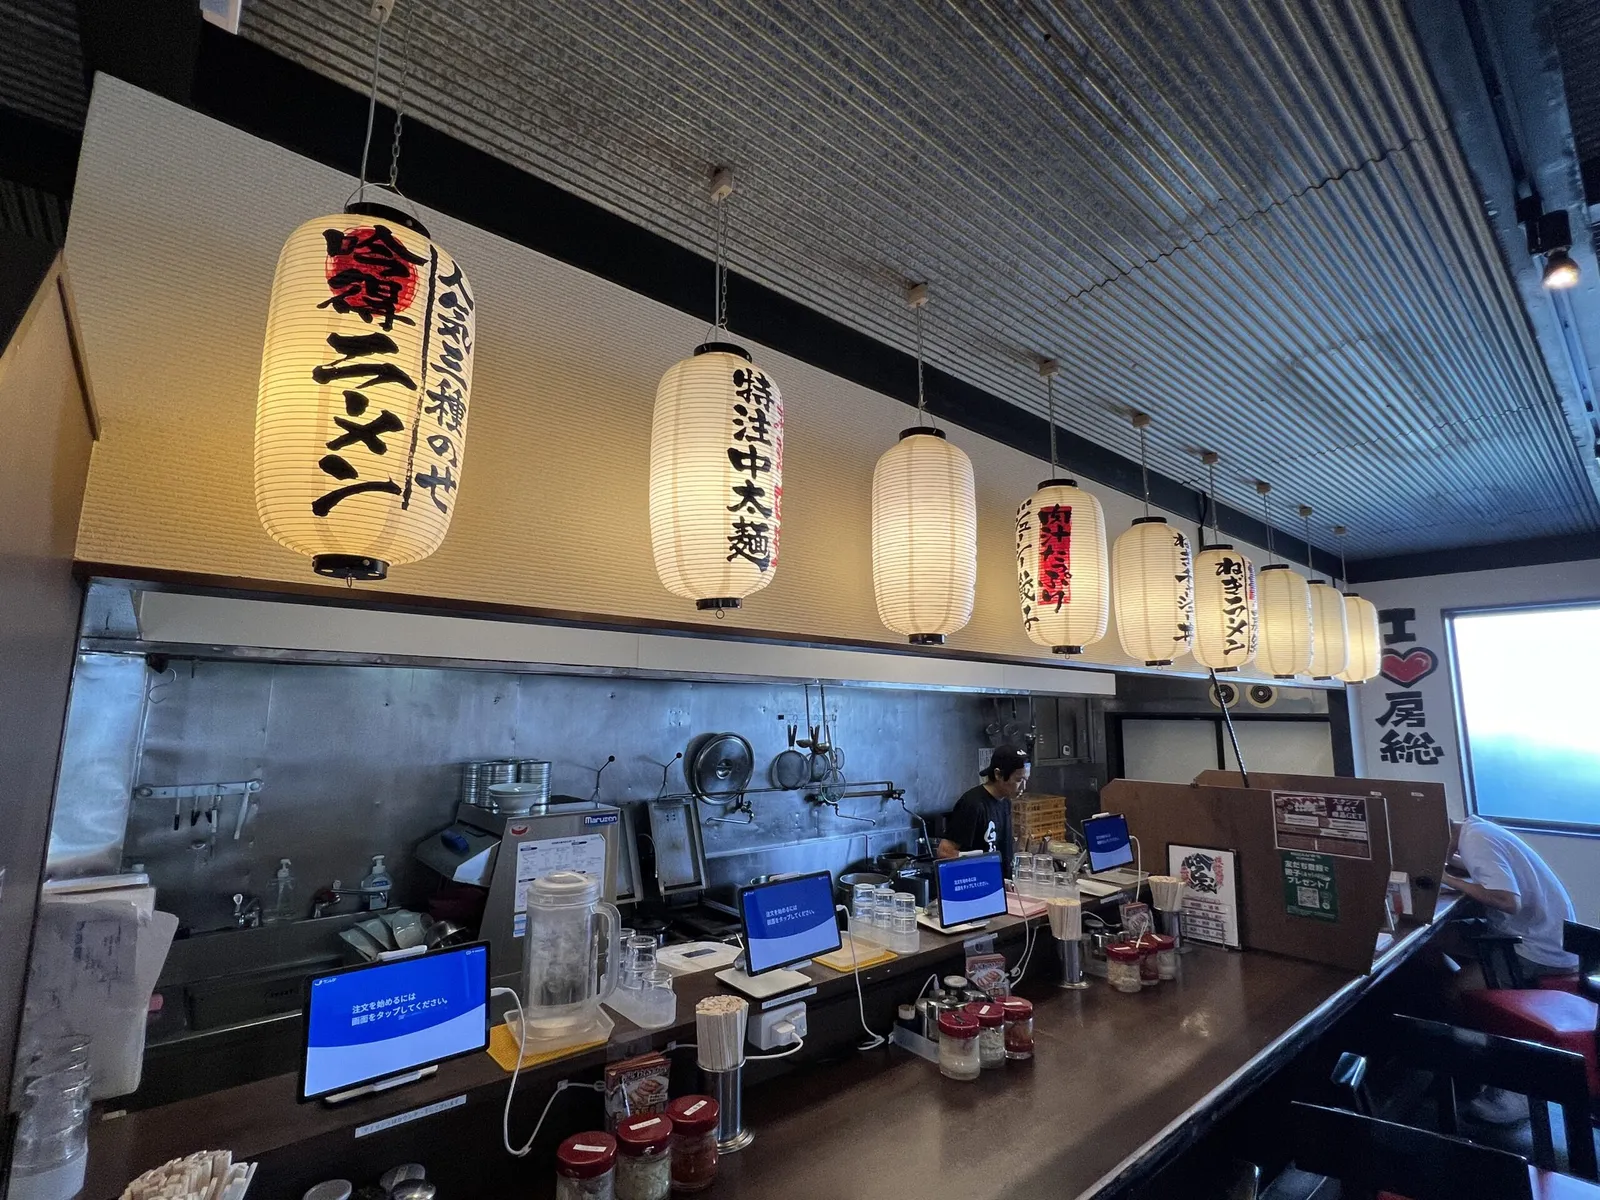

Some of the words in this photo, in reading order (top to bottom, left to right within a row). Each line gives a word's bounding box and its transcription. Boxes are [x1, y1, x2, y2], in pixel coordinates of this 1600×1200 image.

[727, 368, 774, 572] 特注中太麺
[1038, 503, 1073, 614] 肉汁たっぷり
[1375, 691, 1445, 765] 房総
[351, 997, 448, 1026] 画面をタップしてください。
[352, 992, 417, 1014] 注文を始めるには
